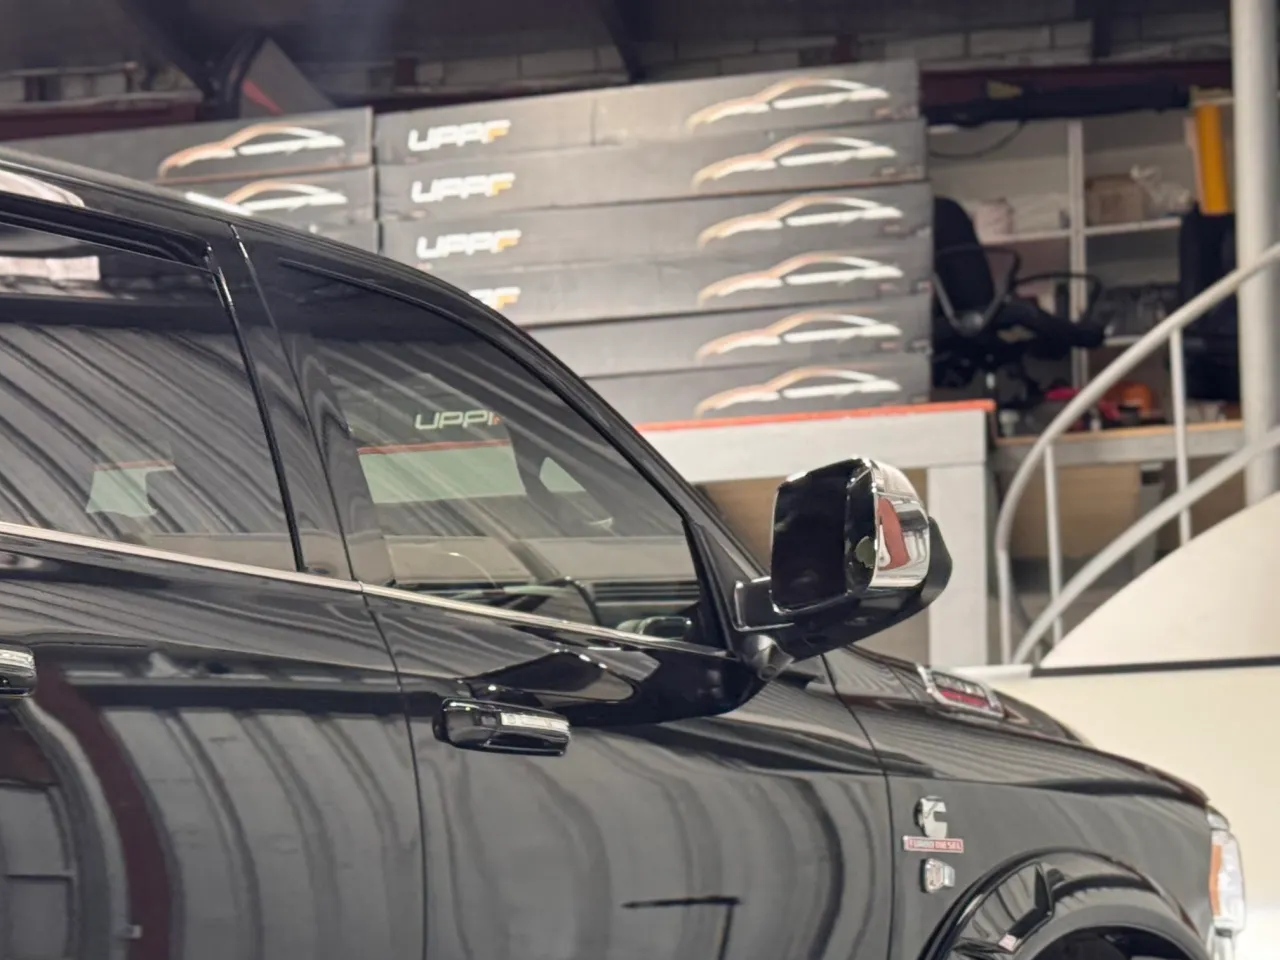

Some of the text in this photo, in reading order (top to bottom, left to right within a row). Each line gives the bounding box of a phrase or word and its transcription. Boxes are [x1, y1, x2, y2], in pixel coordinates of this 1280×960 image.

[408, 119, 511, 151] UPPF
[411, 172, 515, 203] UPPF
[416, 229, 521, 258] UPPF
